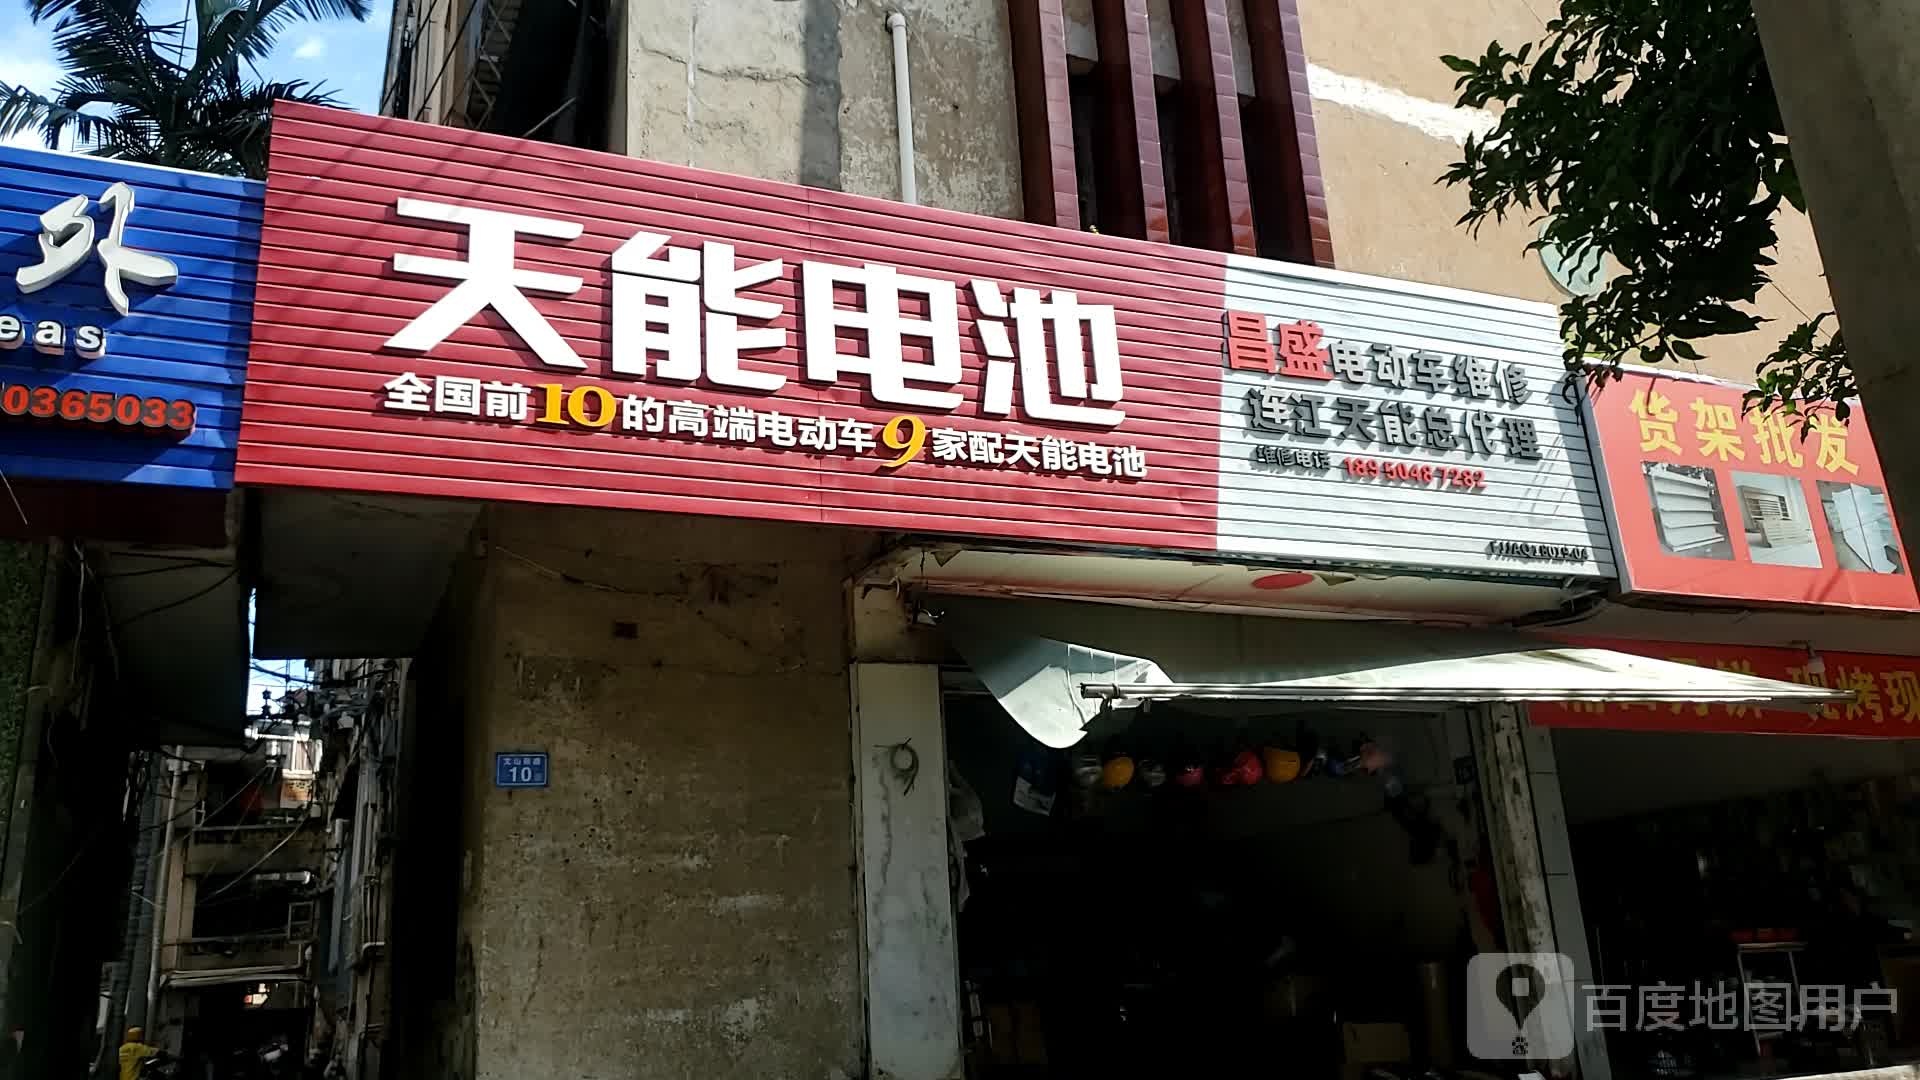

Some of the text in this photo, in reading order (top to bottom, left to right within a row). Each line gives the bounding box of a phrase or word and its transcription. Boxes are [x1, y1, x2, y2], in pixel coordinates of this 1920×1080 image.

[383, 196, 1126, 427] 天能电池
[1248, 385, 1543, 461] 连江天能总代理
[1629, 388, 1860, 476] 货架批发
[509, 766, 532, 782] 10
